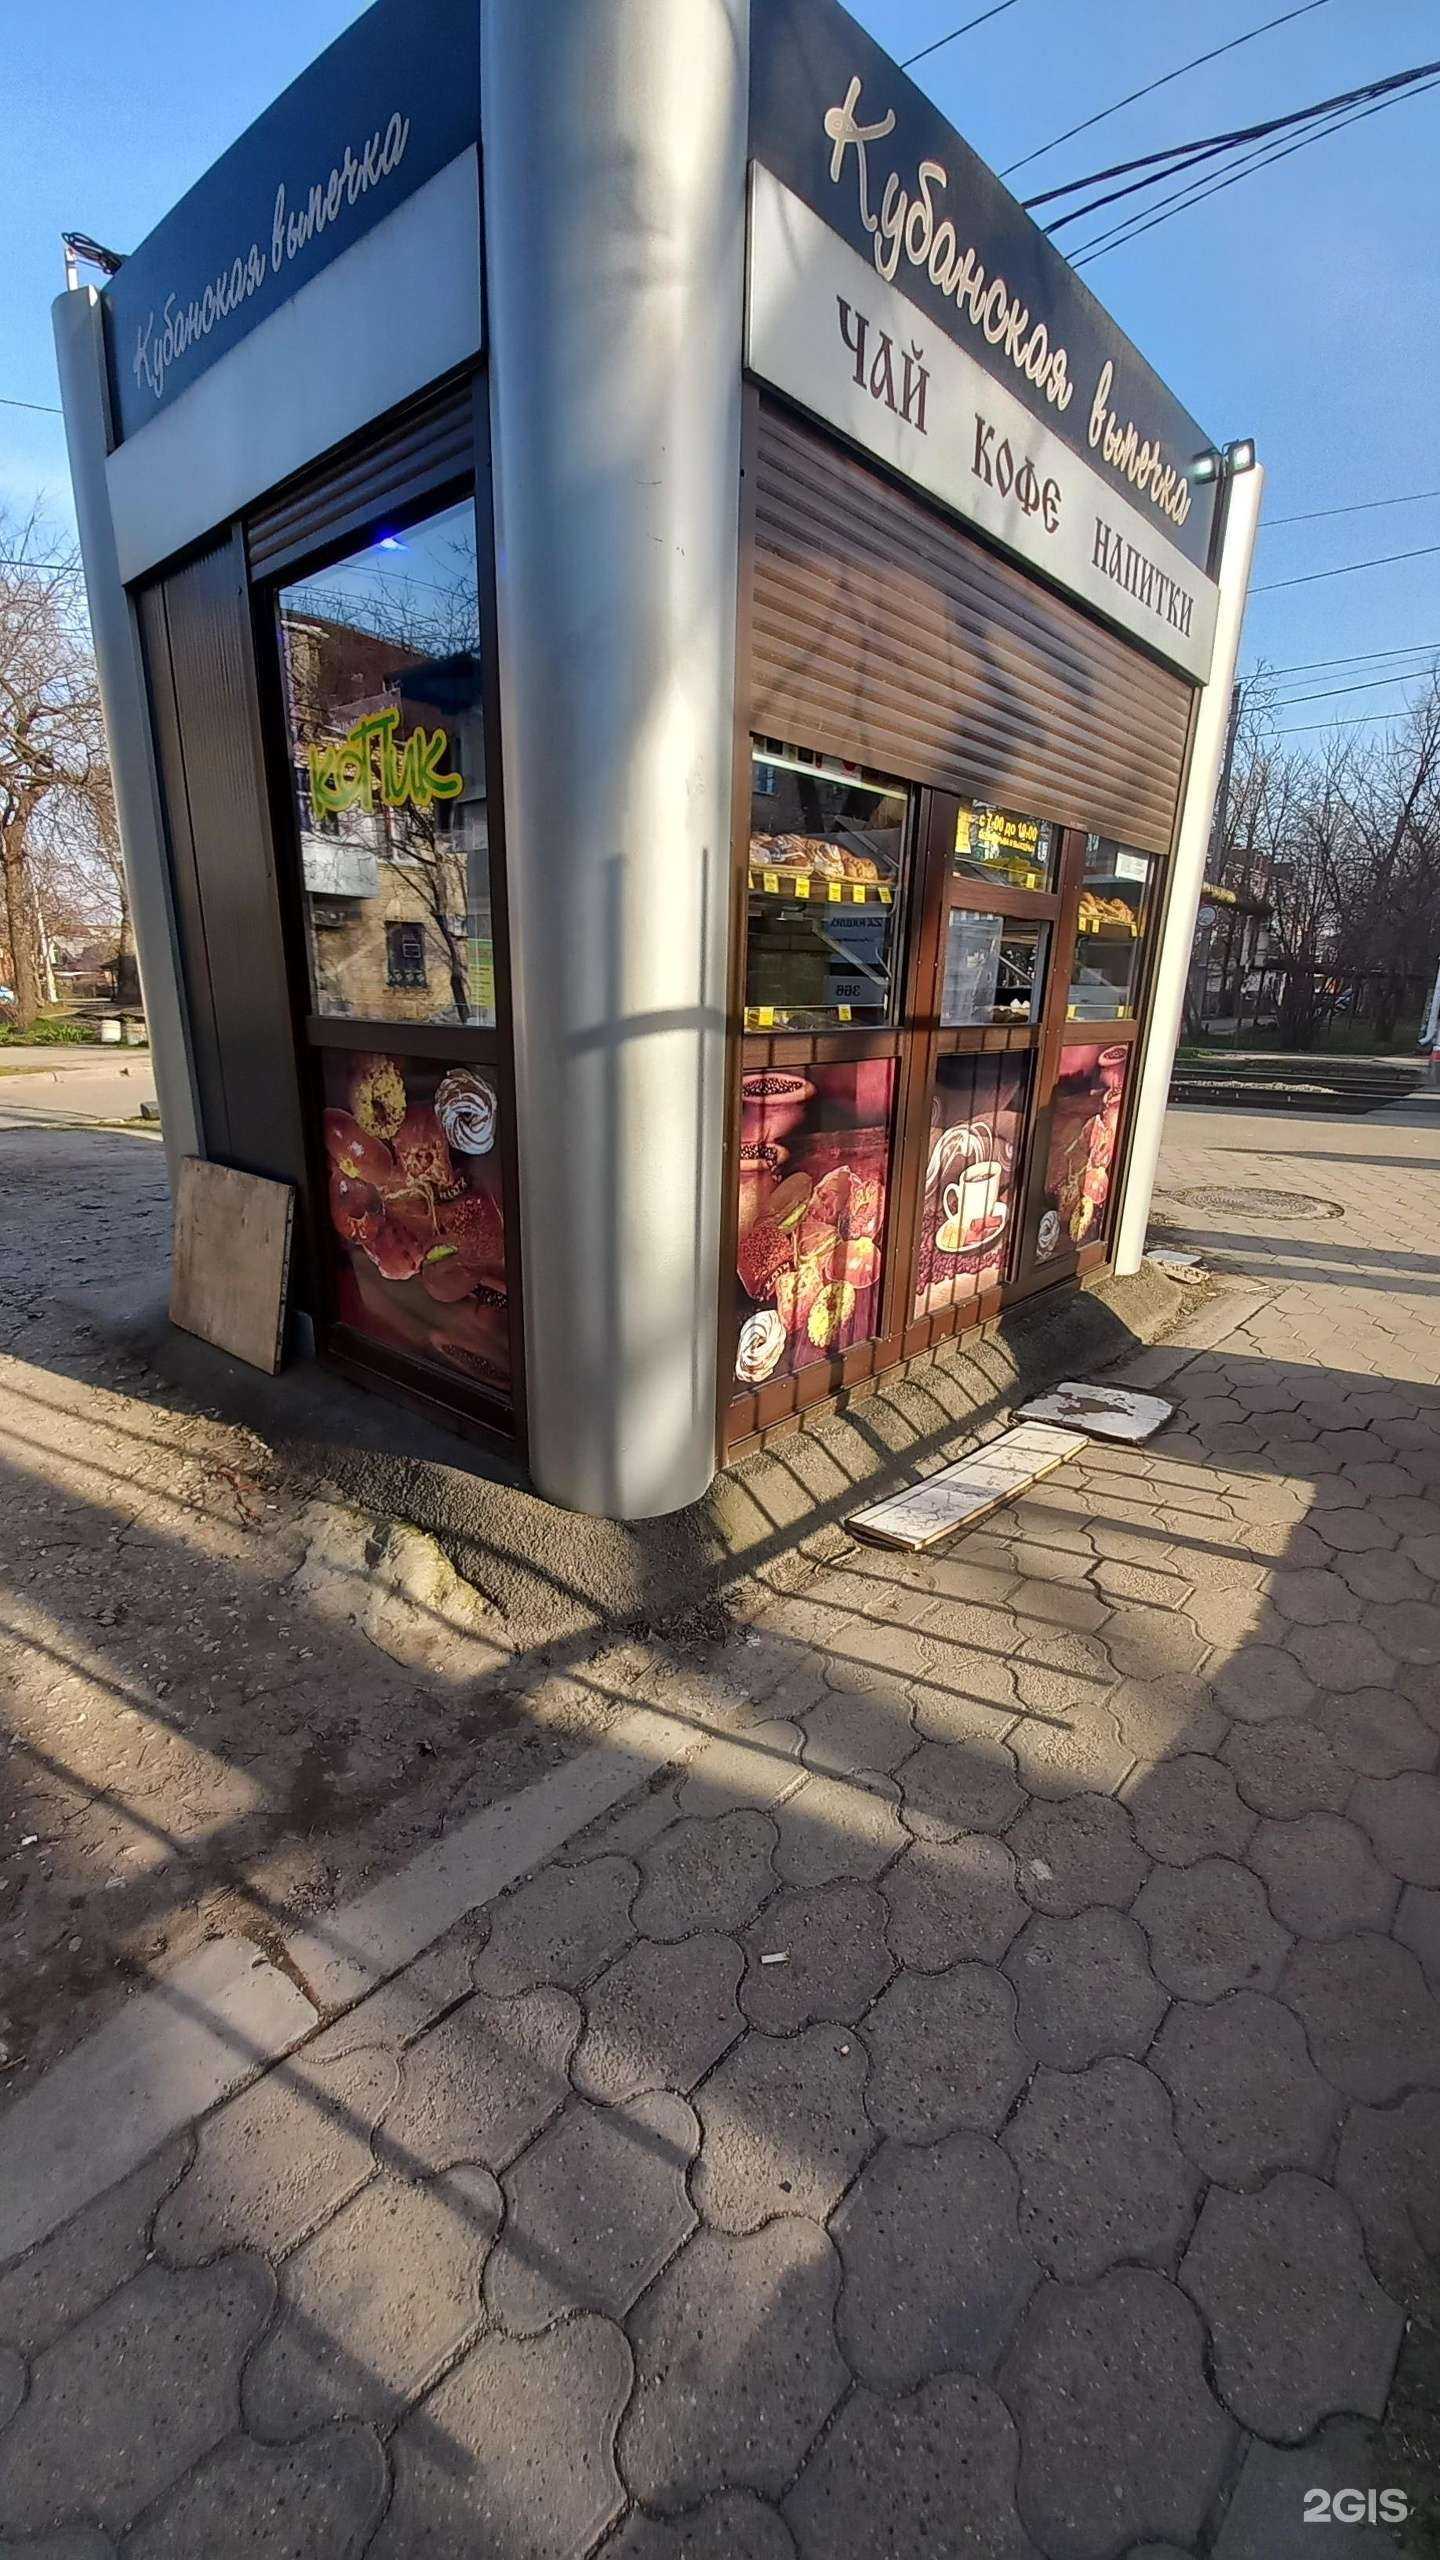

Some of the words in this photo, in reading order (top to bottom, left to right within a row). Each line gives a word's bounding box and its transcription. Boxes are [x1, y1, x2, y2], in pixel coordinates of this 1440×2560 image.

[133, 311, 266, 399] Кубанская
[271, 111, 410, 273] выпечка
[824, 76, 1073, 412] Кубанская
[1088, 360, 1192, 527] выпечка
[836, 294, 932, 435] ЧАЙ
[1091, 516, 1195, 638] НАПИТКИ
